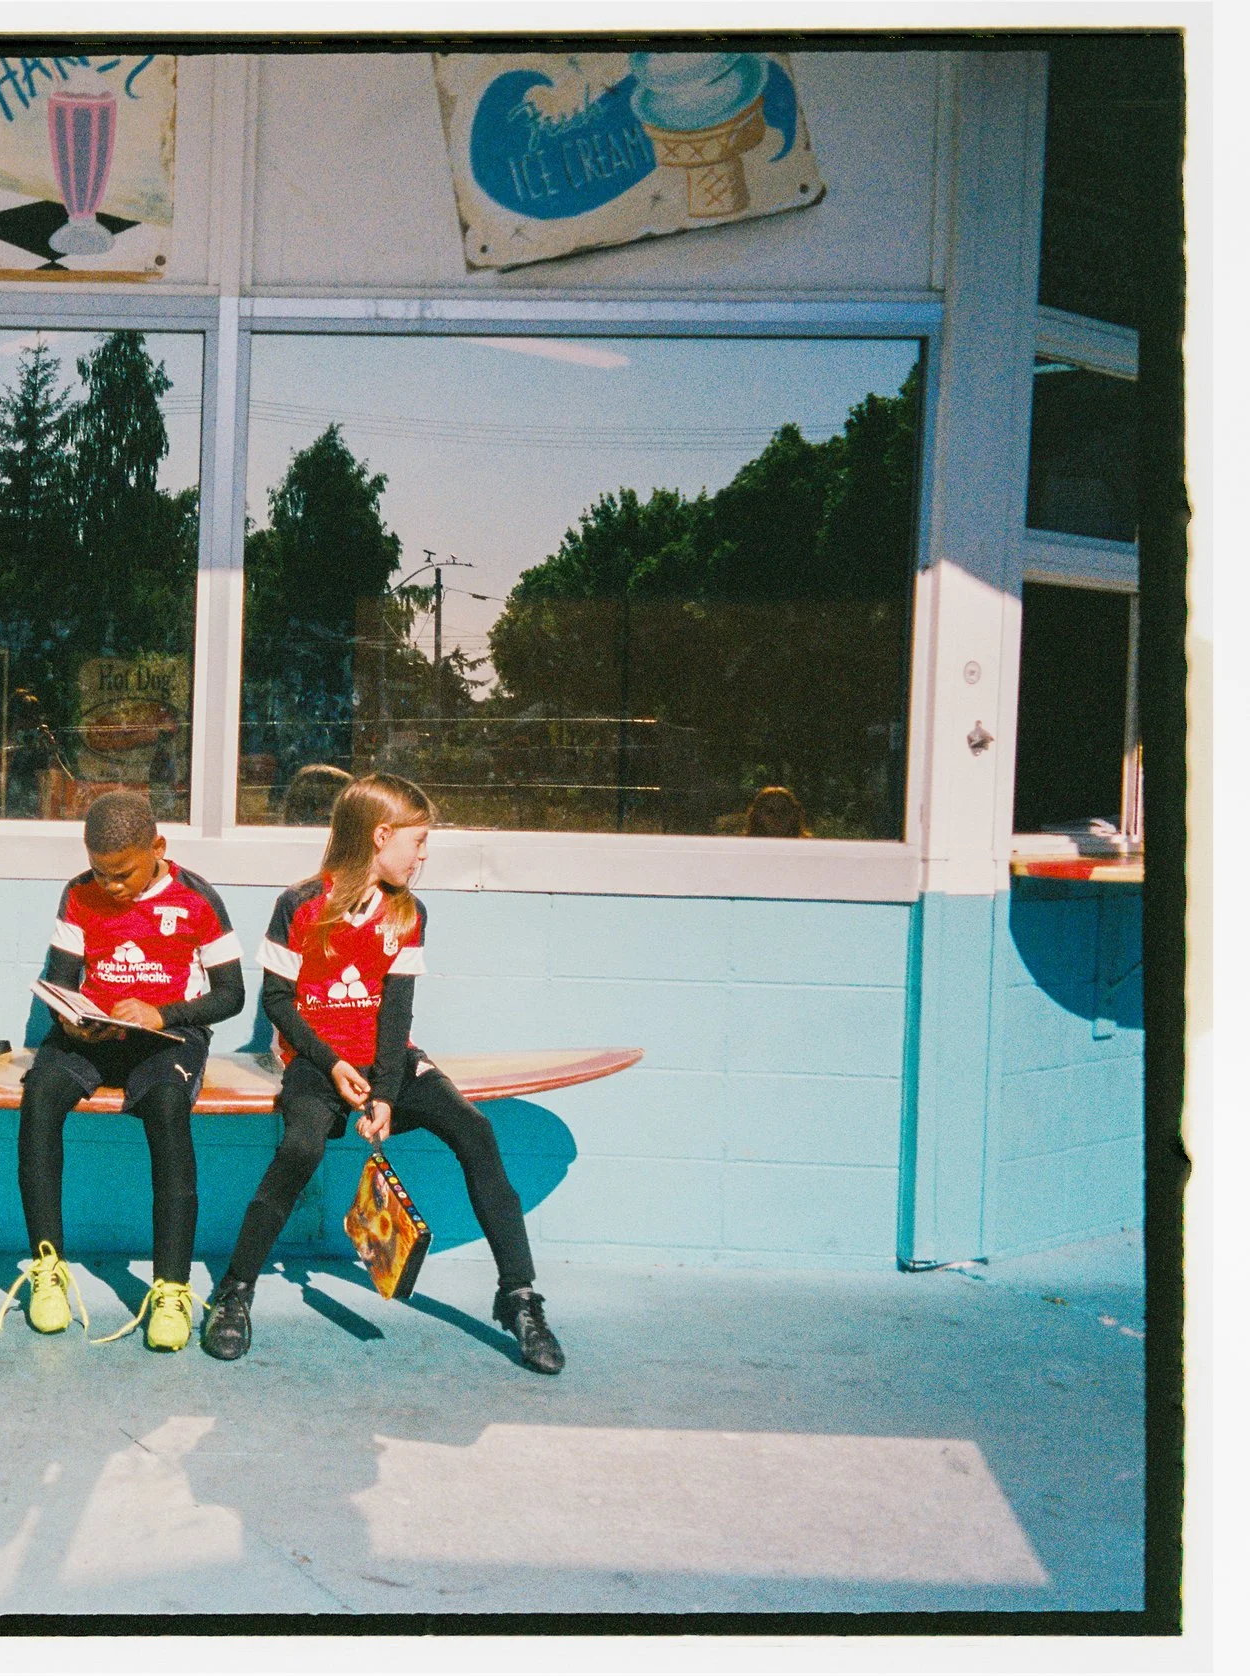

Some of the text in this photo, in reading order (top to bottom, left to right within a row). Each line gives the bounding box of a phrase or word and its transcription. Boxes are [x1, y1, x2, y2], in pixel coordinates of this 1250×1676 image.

[508, 126, 651, 201] ICE CREAM
[128, 961, 163, 972] Mason
[91, 972, 135, 984] nciscan
